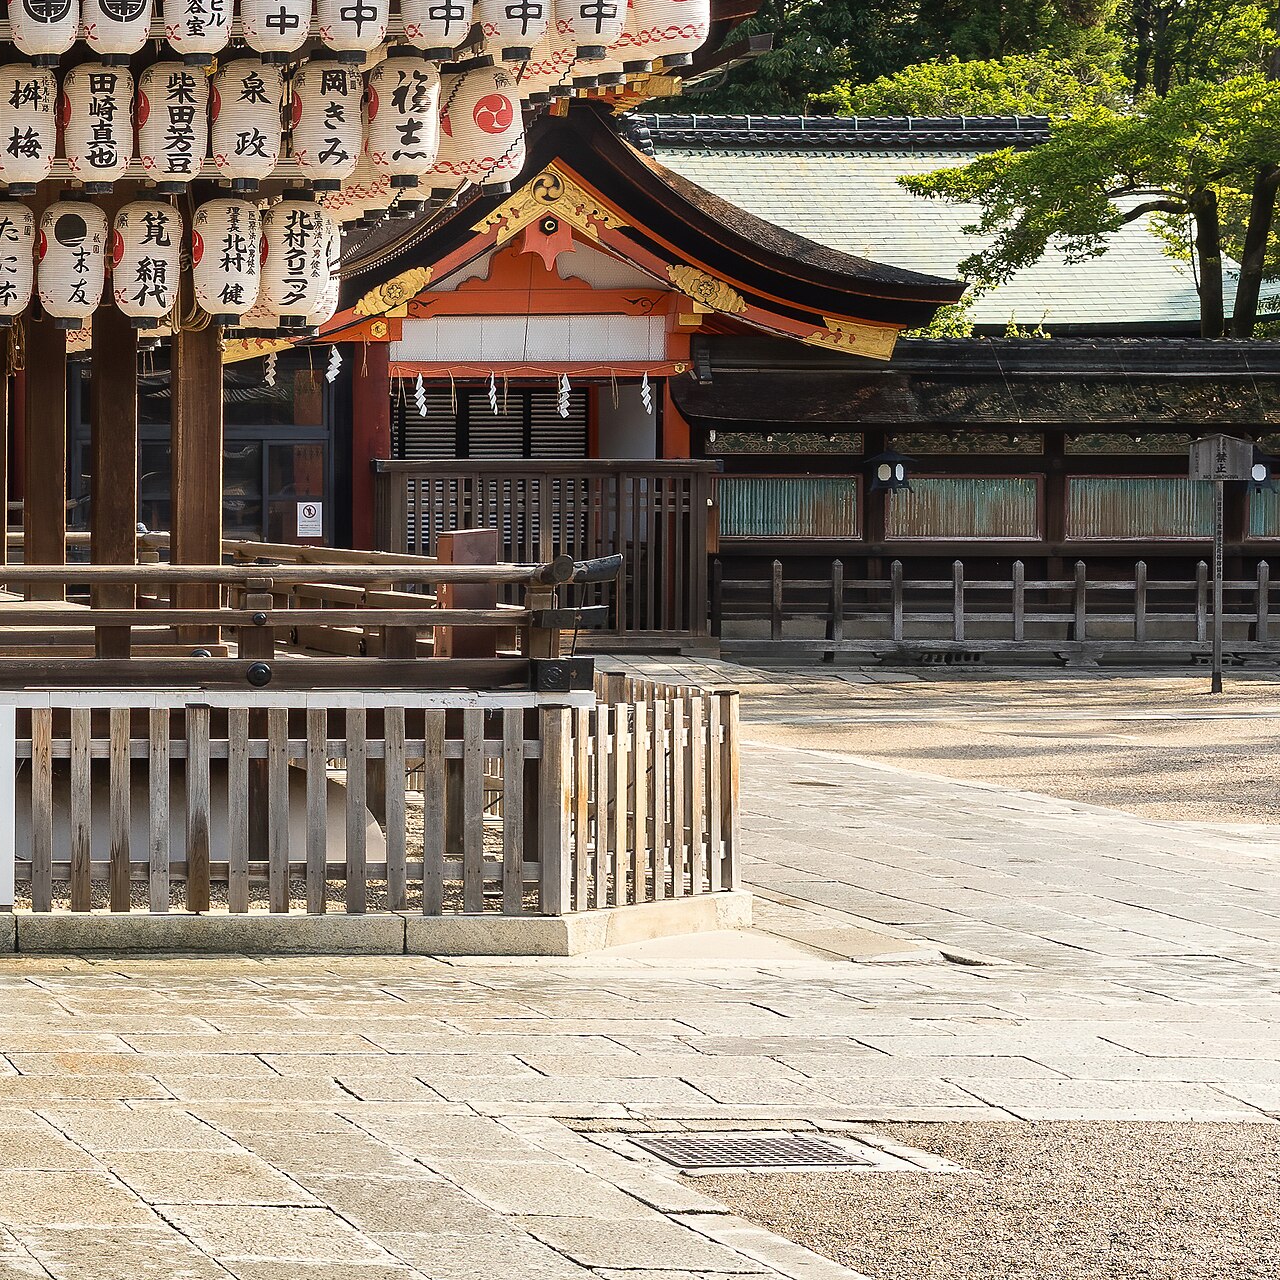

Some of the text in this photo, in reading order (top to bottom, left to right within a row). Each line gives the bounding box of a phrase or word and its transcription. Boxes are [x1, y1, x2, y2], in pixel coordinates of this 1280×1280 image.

[85, 73, 119, 169] 田崎真也
[162, 72, 197, 173] 柴田芳豆
[234, 71, 272, 159] 泉政
[318, 69, 348, 165] 岡きみ
[70, 247, 91, 305] 末友
[131, 210, 171, 308] 筧 絹代
[217, 206, 248, 306] 理事長 北村 健
[278, 210, 314, 306] 北村クリニック
